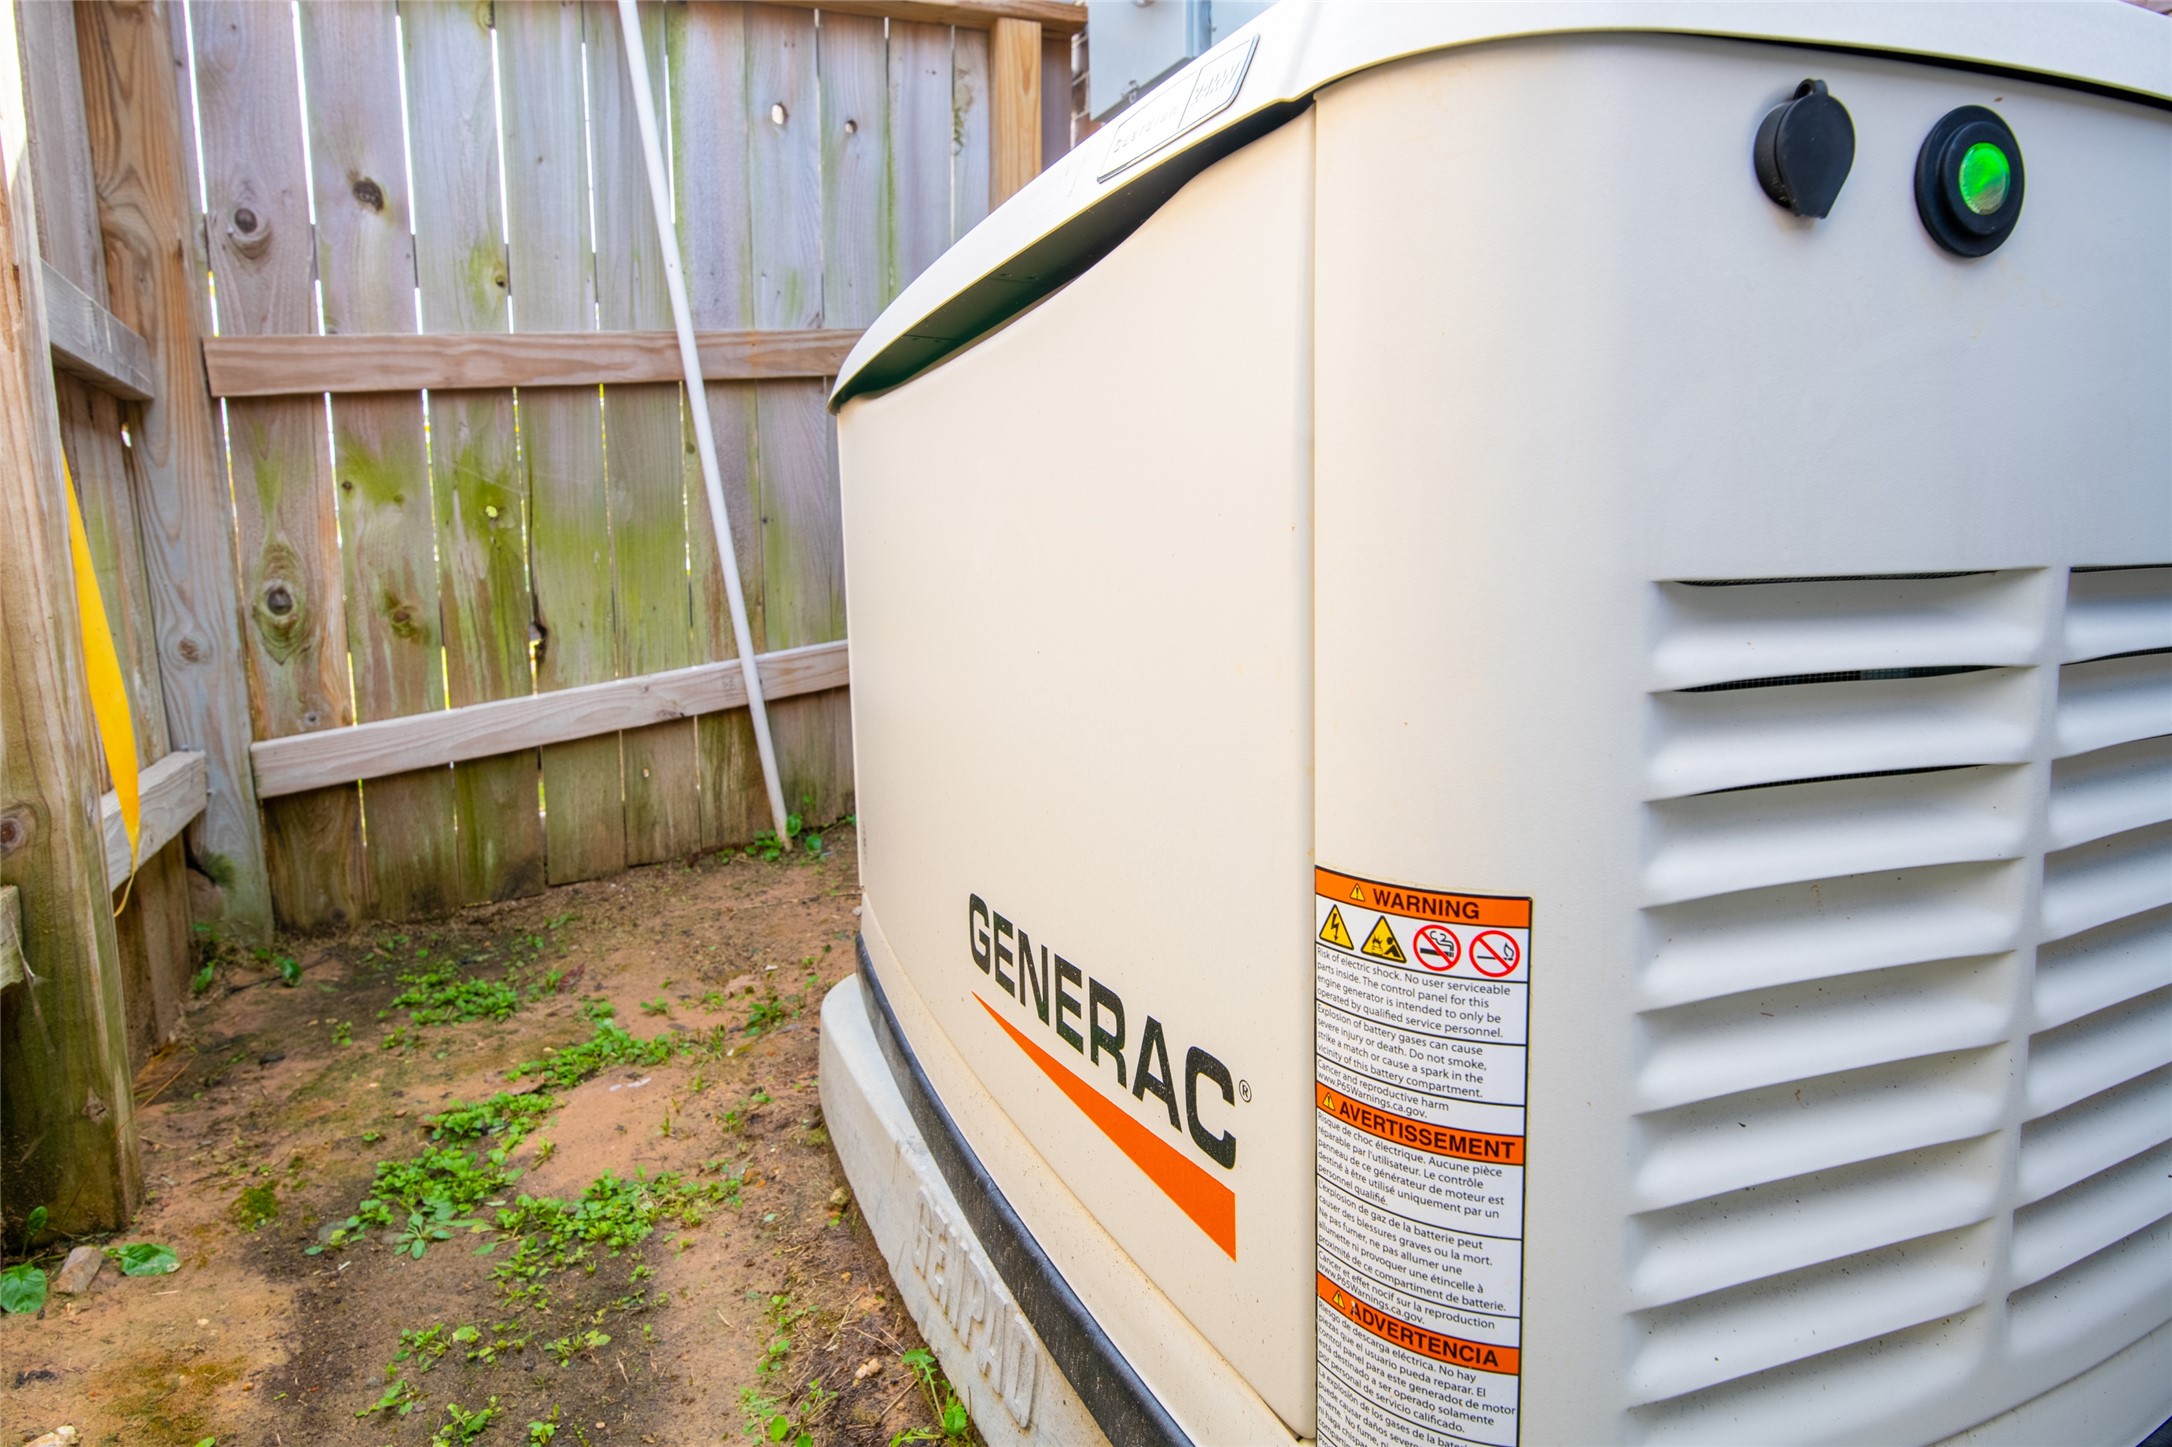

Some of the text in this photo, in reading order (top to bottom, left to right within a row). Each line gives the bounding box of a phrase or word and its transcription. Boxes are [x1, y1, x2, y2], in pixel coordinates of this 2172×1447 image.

[1373, 888, 1479, 920] WARNING
[1342, 985, 1501, 1024] generator is intended to only be
[1362, 975, 1378, 989] The
[1380, 983, 1415, 998] control
[1418, 991, 1447, 1003] panel
[1450, 994, 1466, 1005] for
[1468, 997, 1489, 1008] this
[1404, 972, 1419, 984] No
[1421, 978, 1444, 988] user
[1447, 982, 1510, 995] serviceable
[969, 893, 1236, 1170] GENERAC
[1351, 999, 1503, 1038] by qualified service personnel.
[1353, 1019, 1362, 1029] of
[1363, 1021, 1396, 1041] battery
[1398, 1034, 1426, 1047] gases
[1429, 1040, 1448, 1050] can
[1451, 1044, 1483, 1055] cause
[1341, 1029, 1363, 1045] injury
[1365, 1038, 1375, 1046] or
[1409, 1048, 1424, 1060] Do
[1426, 1054, 1444, 1064] not
[1447, 1057, 1486, 1071] smoke,
[1343, 1043, 1368, 1058] match
[1370, 1053, 1380, 1062] or
[1382, 1057, 1409, 1071] cause
[1411, 1064, 1417, 1073] a
[1420, 1066, 1449, 1079] spark
[1451, 1070, 1462, 1081] in
[1464, 1072, 1483, 1084] the
[1342, 1073, 1357, 1085] and
[1359, 1080, 1418, 1105] reproductive
[1421, 1096, 1448, 1111] harm
[1343, 1056, 1482, 1098] of this battery compartment.
[1341, 1126, 1351, 1137] de
[1353, 1132, 1373, 1147] choc
[1428, 1156, 1469, 1173] Aucune
[1472, 1165, 1502, 1177] pièce
[1352, 1145, 1365, 1156] par
[1423, 1168, 1435, 1180] Le
[1438, 1174, 1483, 1189] contrôle
[1344, 1166, 1499, 1218] à être utilisé uniquement par un
[1349, 1157, 1504, 1205] de ce générateur de moteur est
[1341, 1209, 1492, 1266] des blessures graves ou la mort.
[1358, 1204, 1369, 1216] de
[1370, 1211, 1386, 1224] gaz
[1388, 1217, 1400, 1229] de
[1402, 1221, 1411, 1233] la
[1414, 1225, 1454, 1244] batterie
[1457, 1238, 1482, 1250] peut
[1351, 1242, 1483, 1293] ni provoquer une étincelle à
[1369, 1238, 1380, 1249] ne
[1382, 1244, 1398, 1257] pas
[1400, 1251, 1439, 1269] allumer
[1441, 1264, 1462, 1275] une
[1342, 1269, 1350, 1279] et
[1351, 1275, 1369, 1290] effet
[1371, 1286, 1394, 1301] nocif
[1396, 1297, 1411, 1308] sur
[1413, 1301, 1422, 1312] la
[1424, 1307, 1494, 1329] reproduction
[1351, 1256, 1505, 1311] de ce compartiment de batterie.
[1341, 1320, 1351, 1331] de
[1352, 1327, 1390, 1354] descarga
[1439, 1364, 1454, 1377] No
[1456, 1369, 1476, 1384] hay
[1350, 1302, 1498, 1367] ADVERTENCIA
[1343, 1346, 1364, 1365] panel
[1366, 1361, 1385, 1377] para
[1387, 1373, 1406, 1387] este
[1465, 1398, 1479, 1409] de
[1482, 1403, 1515, 1415] motor
[1355, 1342, 1362, 1352] el
[1364, 1348, 1397, 1370] usuario
[1399, 1365, 1430, 1383] pueda
[1433, 1378, 1473, 1395] reparar.
[1476, 1387, 1485, 1397] El
[1363, 1384, 1374, 1396] de
[1375, 1392, 1411, 1415] servicio
[1413, 1410, 1464, 1433] calificado.
[1371, 1377, 1376, 1385] a
[1378, 1381, 1391, 1393] ser
[1393, 1389, 1435, 1411] operado
[1438, 1406, 1494, 1426] solamente
